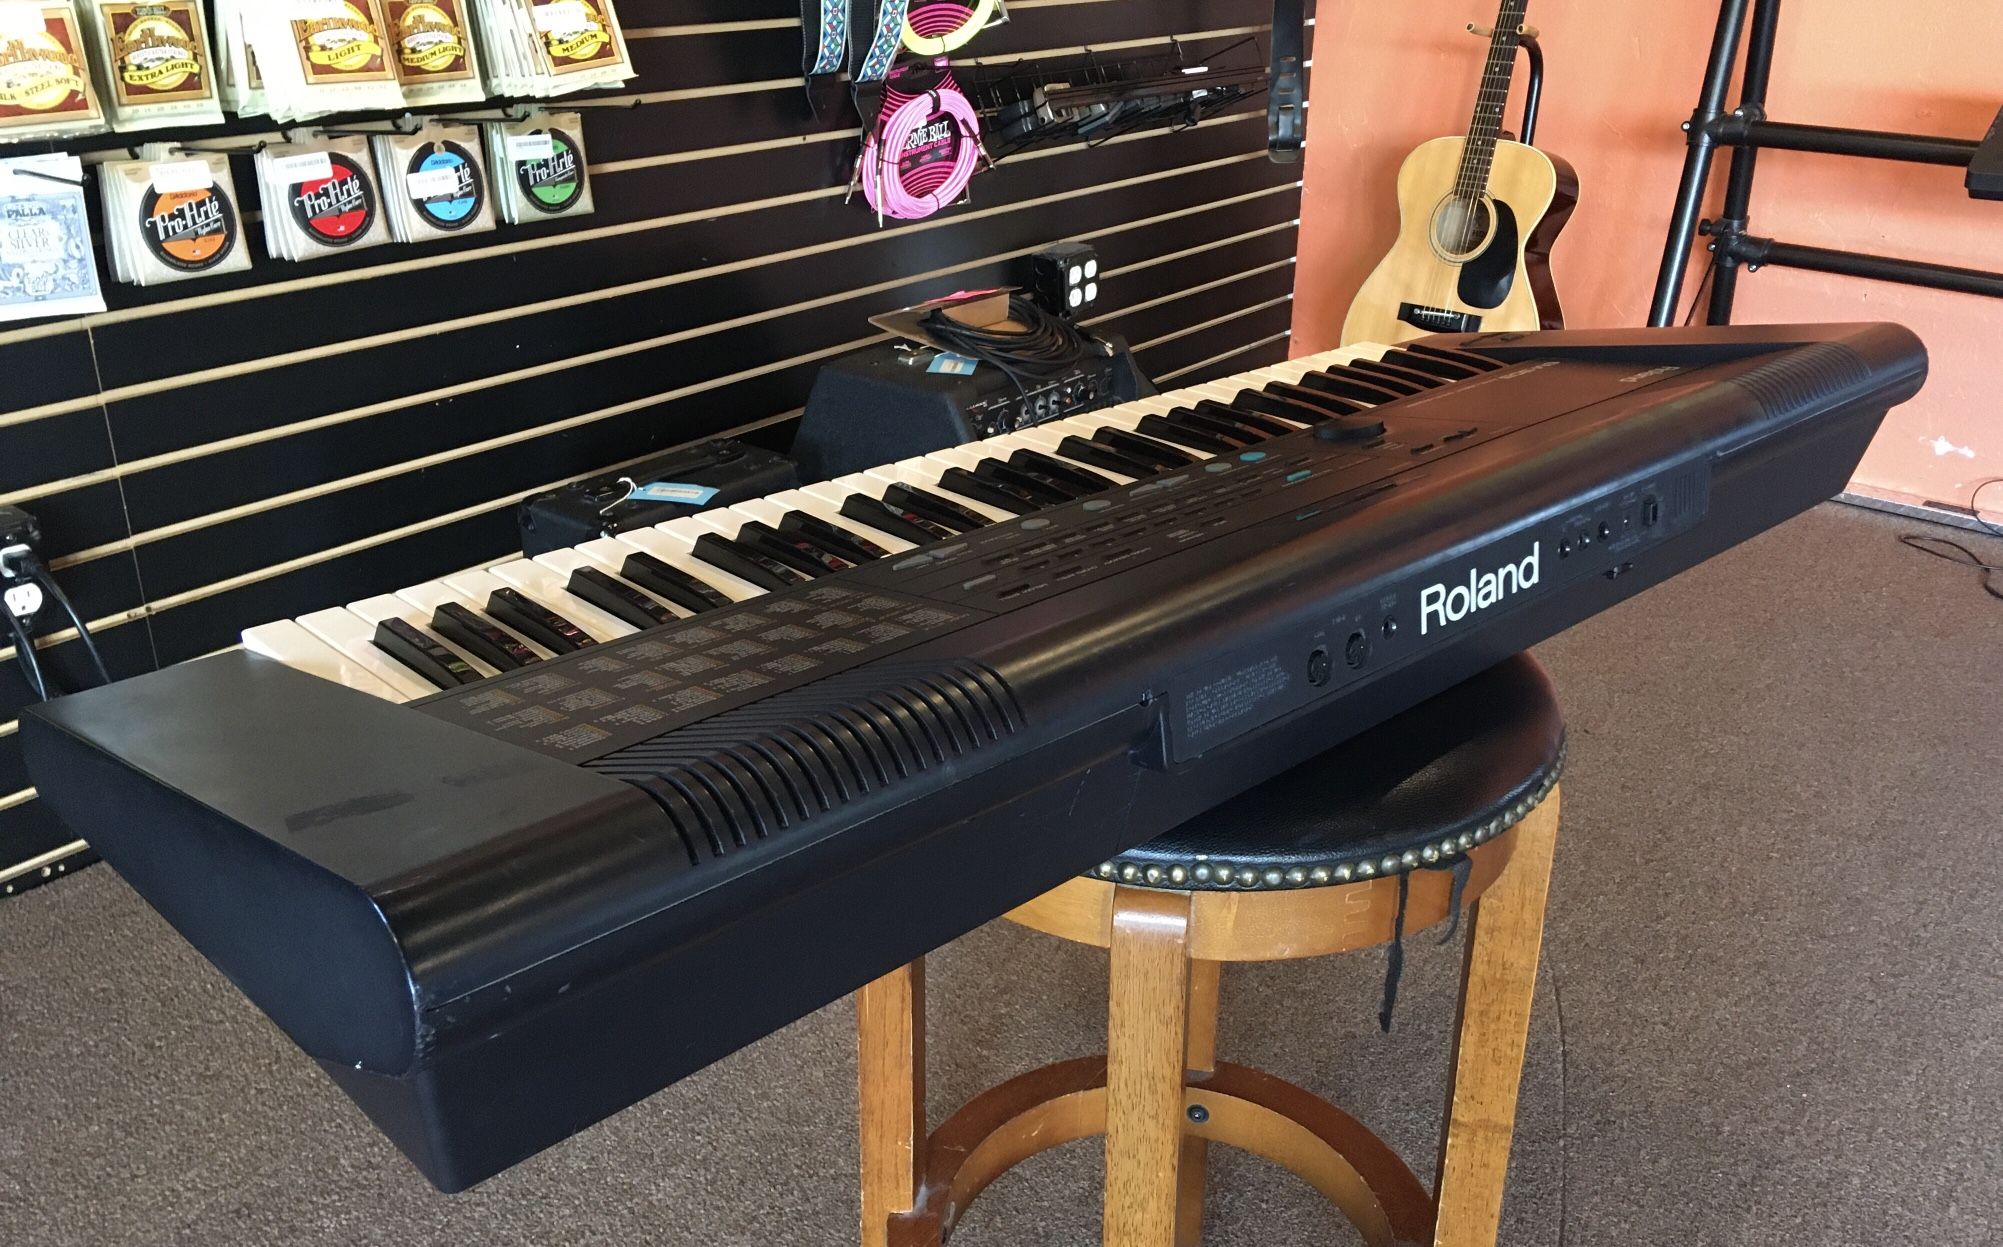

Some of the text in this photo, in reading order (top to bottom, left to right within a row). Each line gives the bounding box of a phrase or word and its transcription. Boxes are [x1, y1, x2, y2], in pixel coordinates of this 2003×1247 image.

[327, 44, 362, 61] LIGHT
[562, 33, 598, 54] MEDIUM
[402, 46, 463, 64] MEDIUM LIGHT
[129, 61, 195, 82] EXTRA LIGHT
[928, 120, 951, 143] BALL
[6, 207, 47, 219] PALLA
[1420, 541, 1540, 636] Roland
